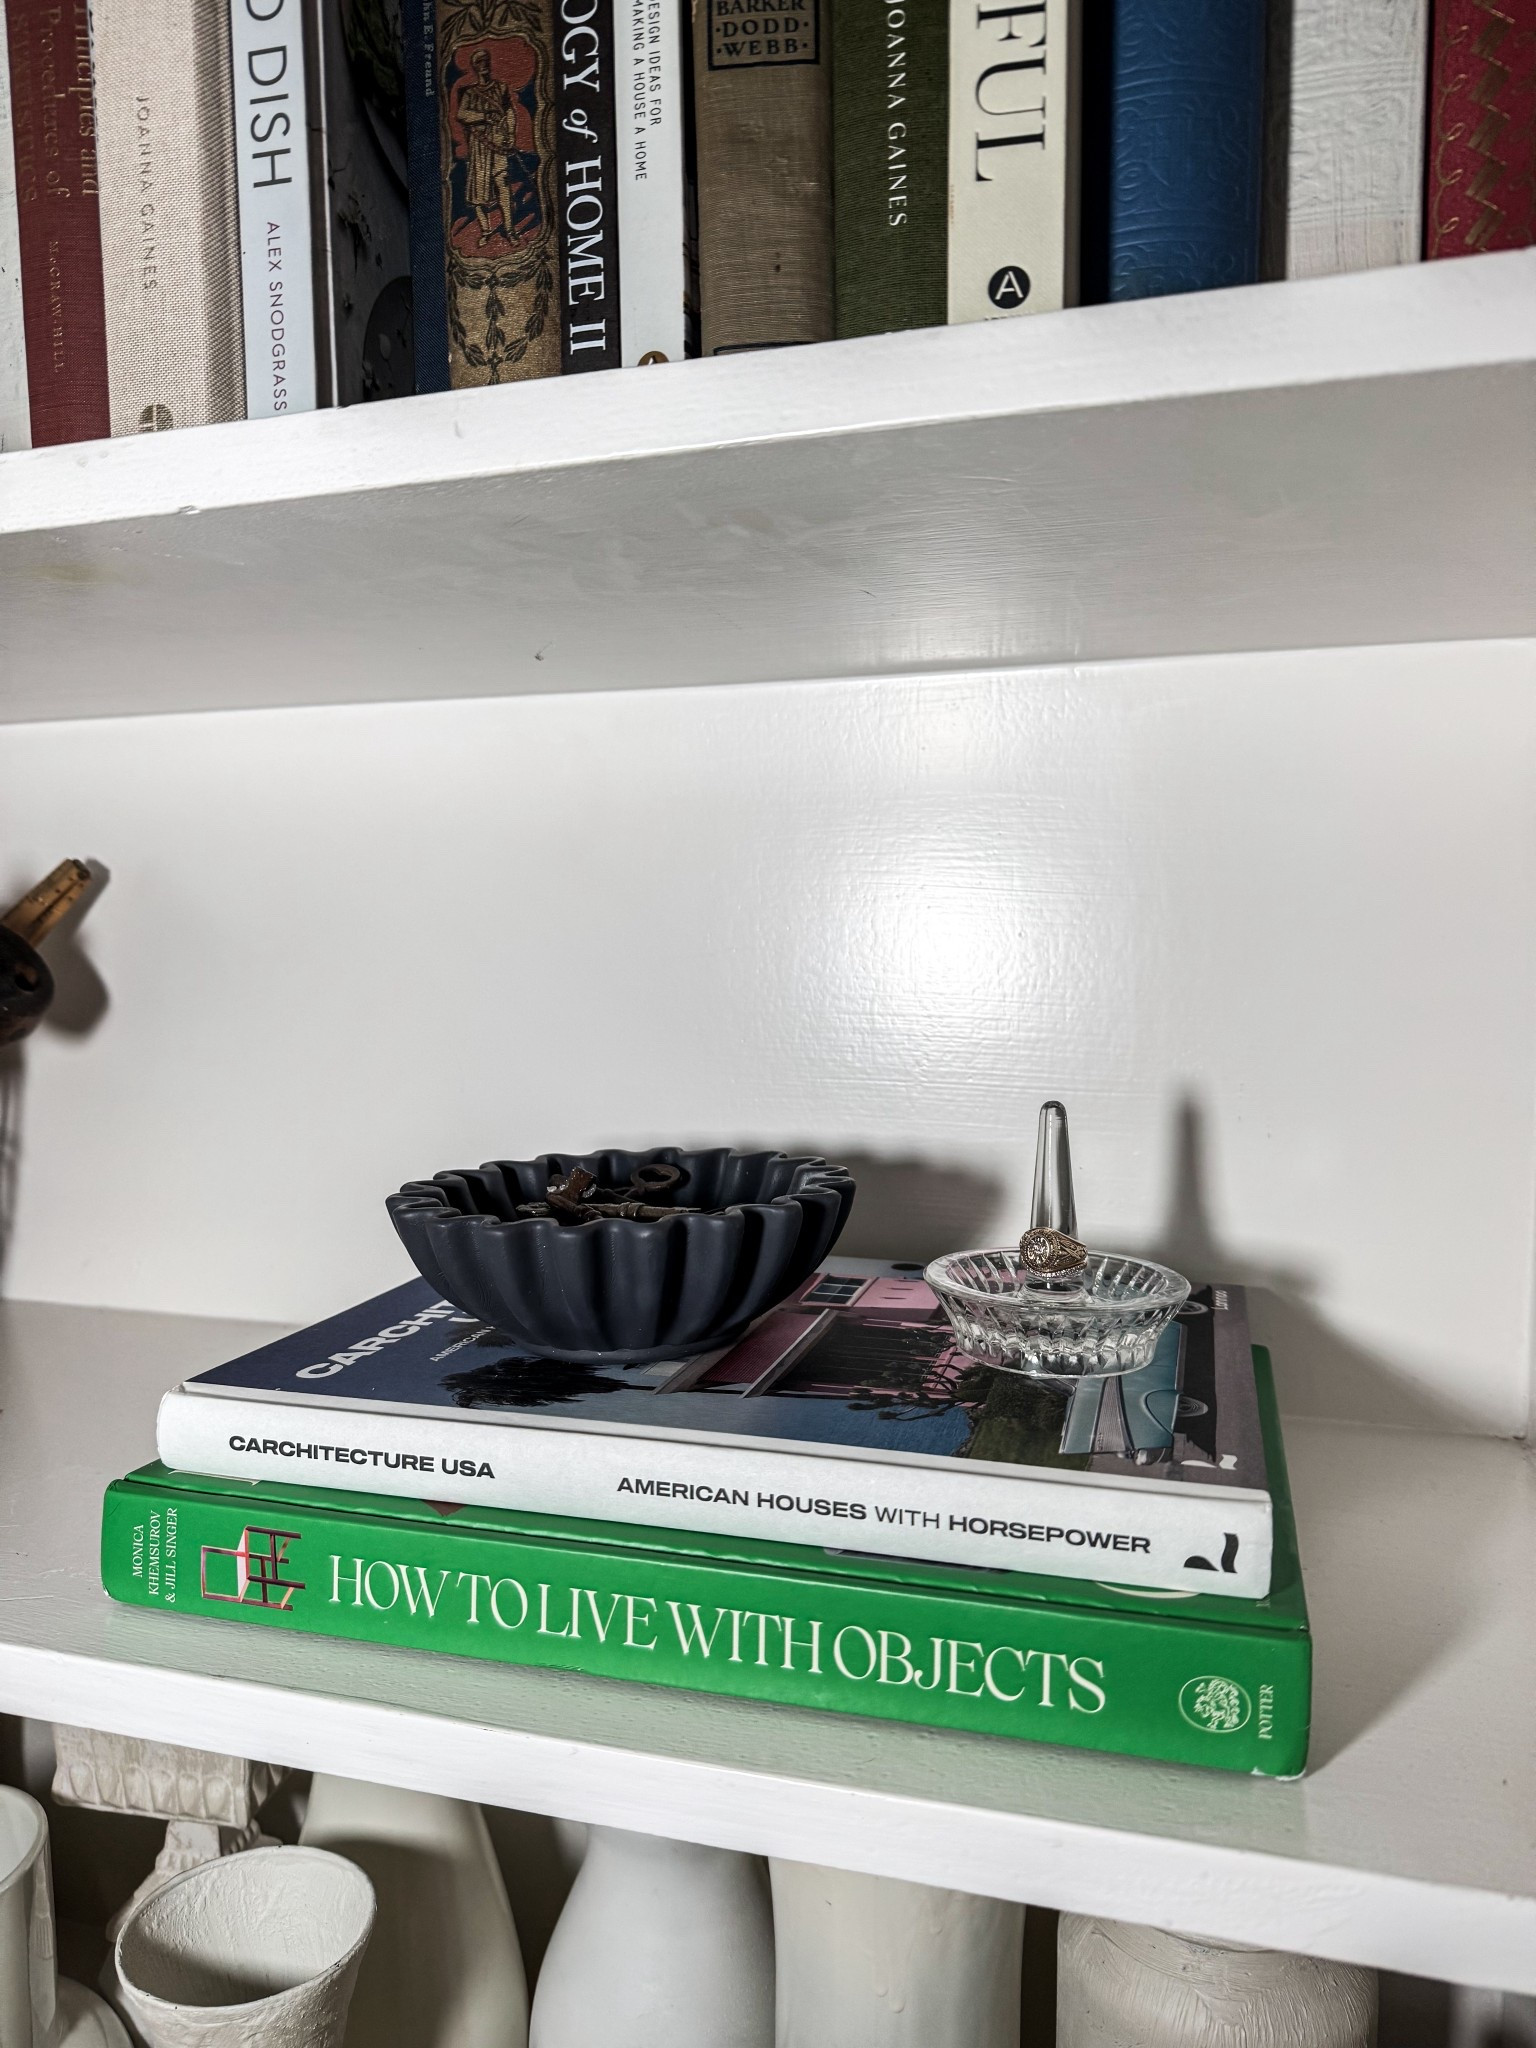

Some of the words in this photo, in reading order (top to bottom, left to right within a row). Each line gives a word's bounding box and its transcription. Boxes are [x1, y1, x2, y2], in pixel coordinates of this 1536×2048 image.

[632, 0, 645, 51] MAKING
[648, 0, 661, 44] ESIGN
[716, 0, 805, 16] BARKER
[40, 6, 66, 157] Procedures
[424, 43, 435, 97] Freund
[632, 57, 645, 66] A
[648, 50, 662, 92] IDEAS
[248, 45, 292, 188] DISH
[633, 72, 646, 120] HOUSE
[649, 98, 662, 126] FOR
[975, 2, 1047, 182] FUL
[136, 96, 153, 193] JOANNA
[562, 108, 598, 144] of
[634, 126, 646, 135] A
[47, 170, 71, 199] of
[635, 140, 647, 181] HOME
[887, 122, 907, 226] GAINES
[141, 203, 158, 290] GAINES
[267, 222, 282, 272] ALEX
[565, 155, 605, 306] HOME
[269, 281, 288, 411] SNODGRASS
[569, 318, 606, 355] II
[429, 1329, 492, 1362] AMERICAN
[229, 1435, 435, 1473] CARCHITECTURE
[441, 1457, 496, 1479] USA
[166, 1507, 178, 1558] SINGER
[616, 1477, 749, 1506] AMERICAN
[757, 1492, 867, 1520] HOUSES
[874, 1505, 940, 1529] WITH
[949, 1515, 1151, 1554] HORSEPOWER
[132, 1524, 144, 1578] MONICA
[148, 1510, 161, 1596] KHEMSUROV
[165, 1561, 177, 1590] JILL
[165, 1592, 176, 1603] &
[329, 1554, 451, 1618] HOW
[456, 1570, 528, 1629] TO
[537, 1582, 658, 1651] LIVE
[665, 1600, 823, 1674] WITH
[833, 1625, 1107, 1714] OBJECTS
[1258, 1684, 1274, 1740] POTTER
